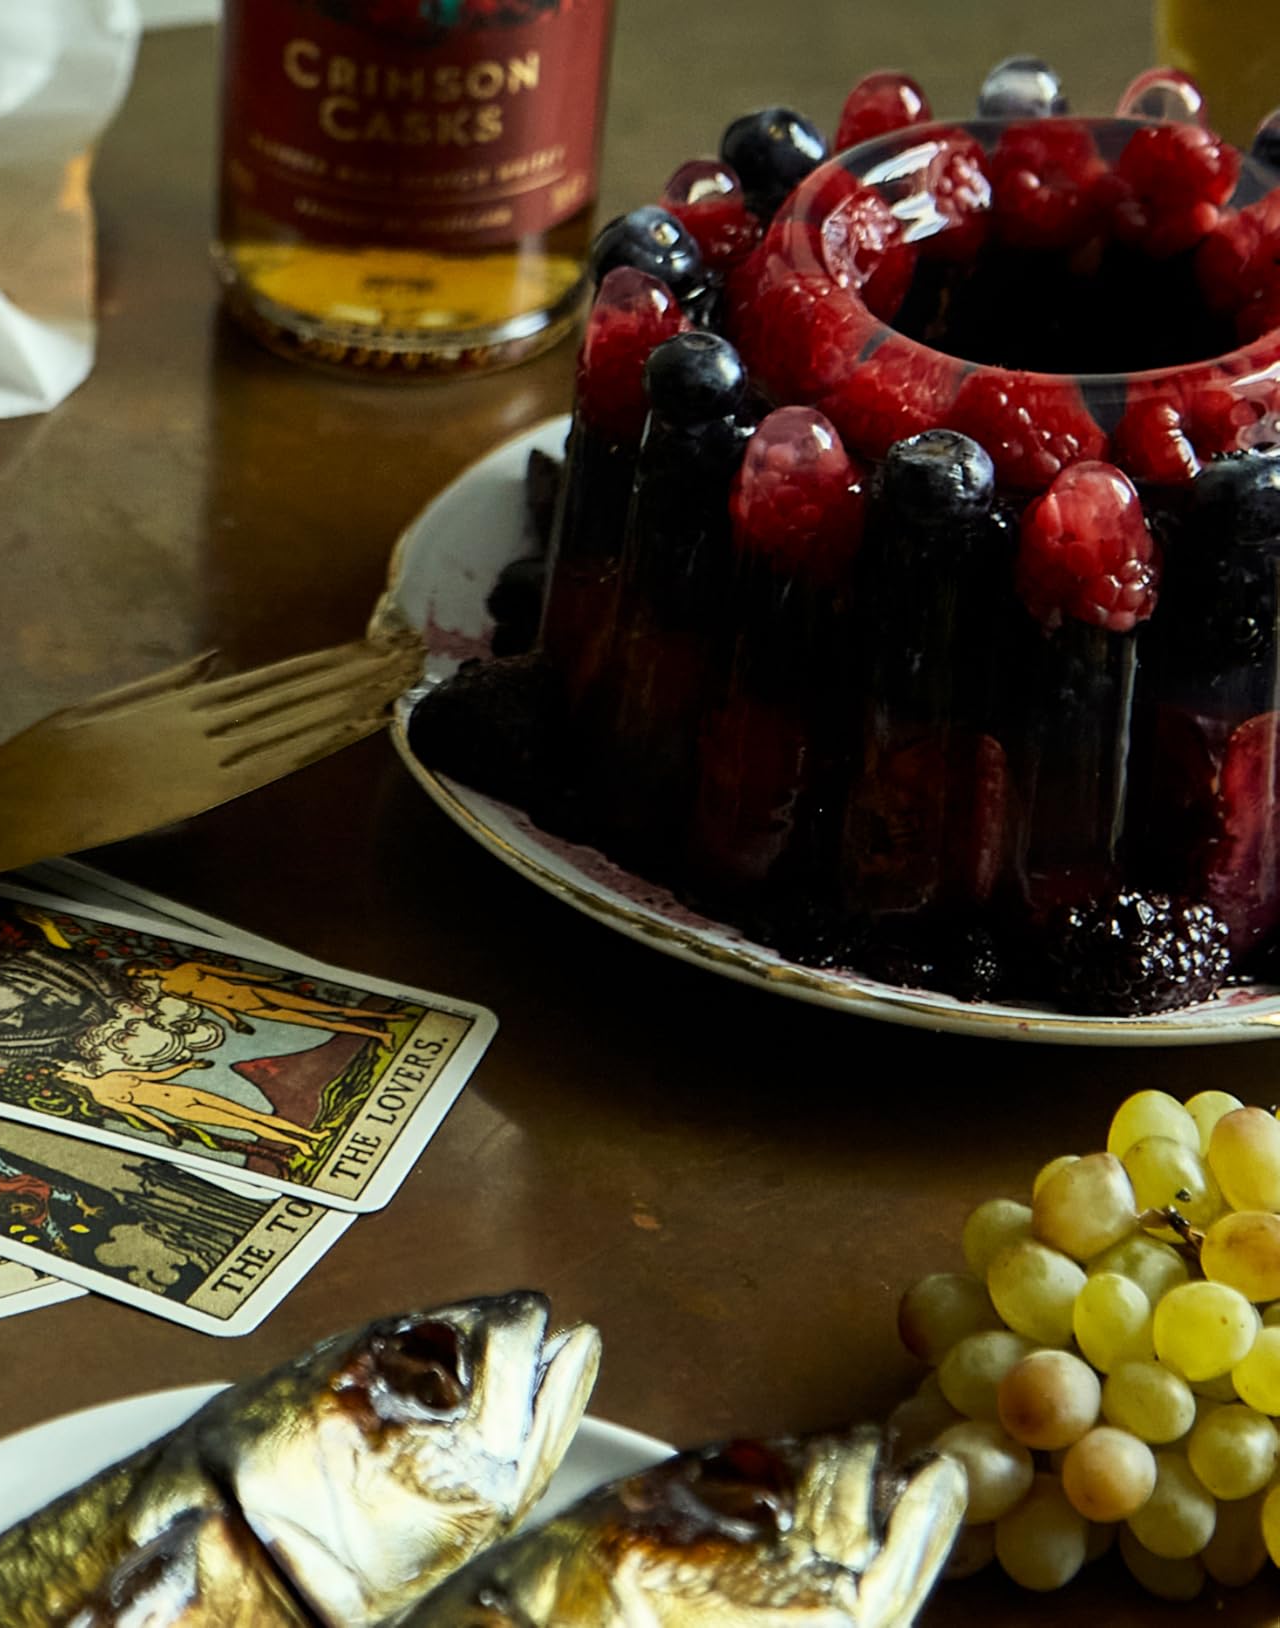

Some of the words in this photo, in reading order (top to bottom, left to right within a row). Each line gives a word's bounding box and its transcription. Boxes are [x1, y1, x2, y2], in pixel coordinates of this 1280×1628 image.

[281, 38, 541, 104] CRIMSON
[318, 95, 504, 145] CASKS
[329, 1132, 381, 1181] THE
[366, 1037, 449, 1126] LOVERS.
[212, 1245, 275, 1295] THE
